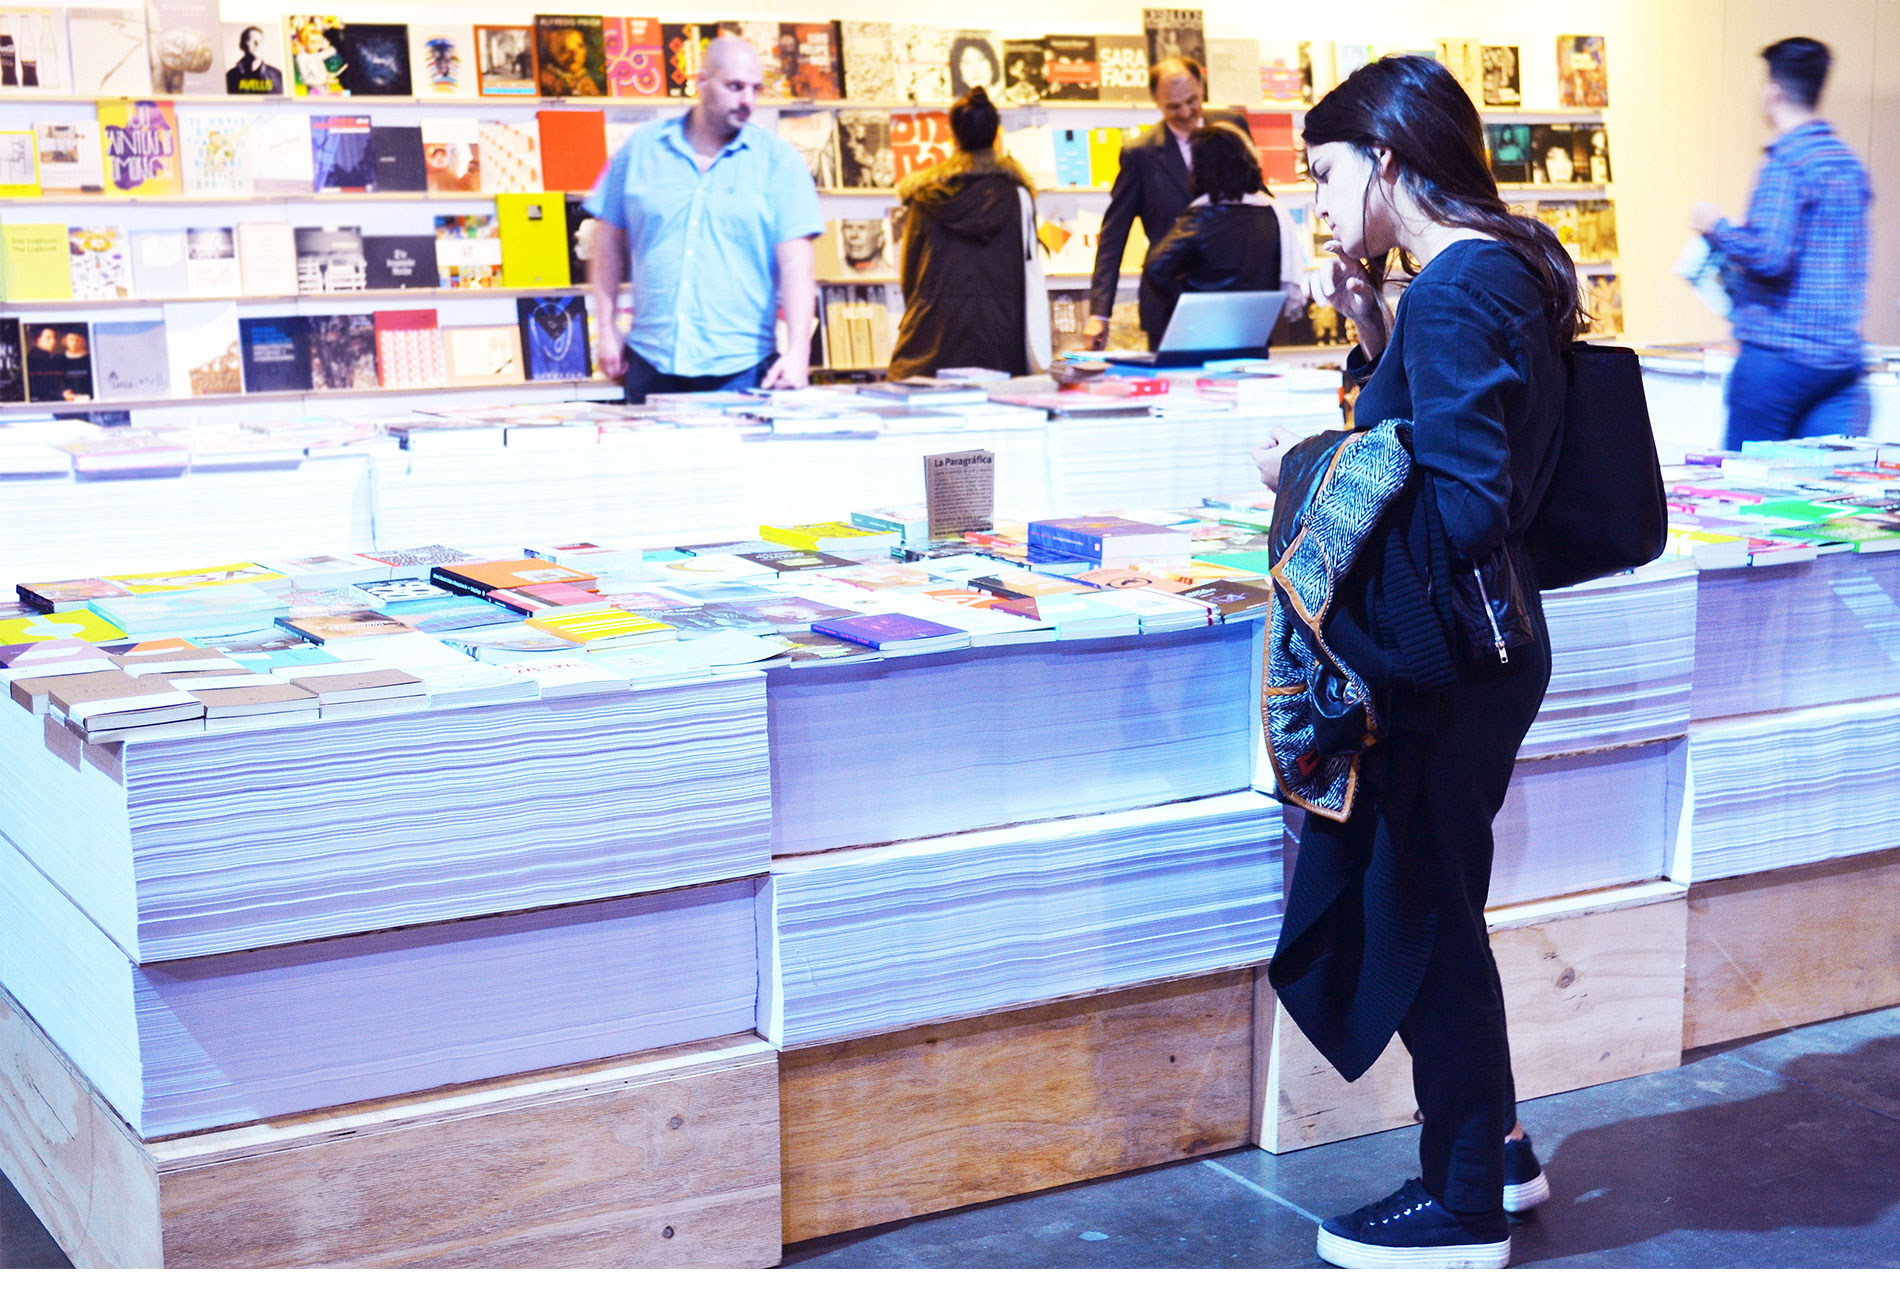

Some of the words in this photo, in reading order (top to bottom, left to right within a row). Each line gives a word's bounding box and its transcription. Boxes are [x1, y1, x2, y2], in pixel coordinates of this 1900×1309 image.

[1099, 48, 1147, 68] SARA
[1101, 68, 1149, 88] FACIO
[935, 459, 944, 468] La
[945, 455, 992, 467] Paragráfica
